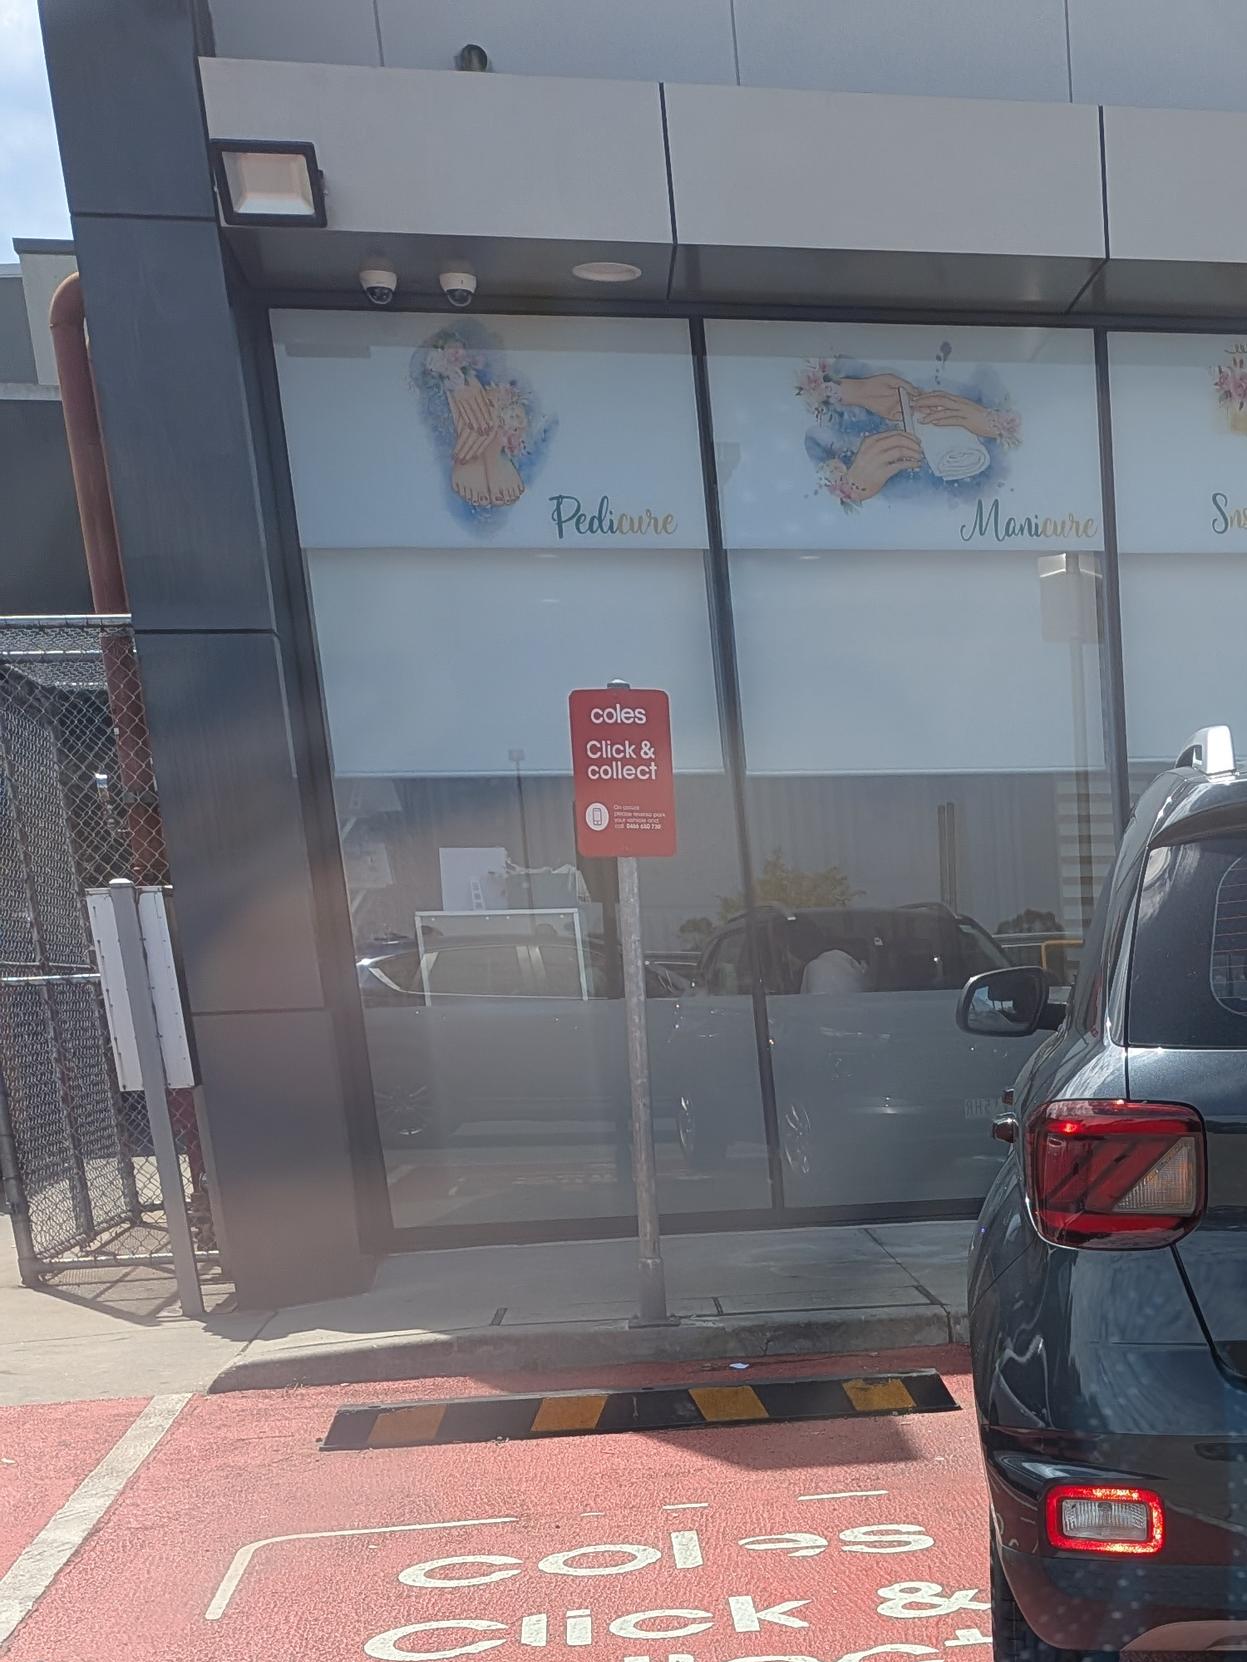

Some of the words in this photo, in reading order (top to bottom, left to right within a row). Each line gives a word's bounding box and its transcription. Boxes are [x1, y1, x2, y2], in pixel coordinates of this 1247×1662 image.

[548, 494, 678, 539] Pedicure
[960, 498, 1098, 542] Manicure
[590, 703, 647, 724] coles
[586, 740, 637, 759] Click
[640, 740, 655, 759] &
[587, 761, 657, 780] collect
[397, 1523, 934, 1589] coles
[363, 1595, 812, 1662] Click
[877, 1580, 992, 1619] &
